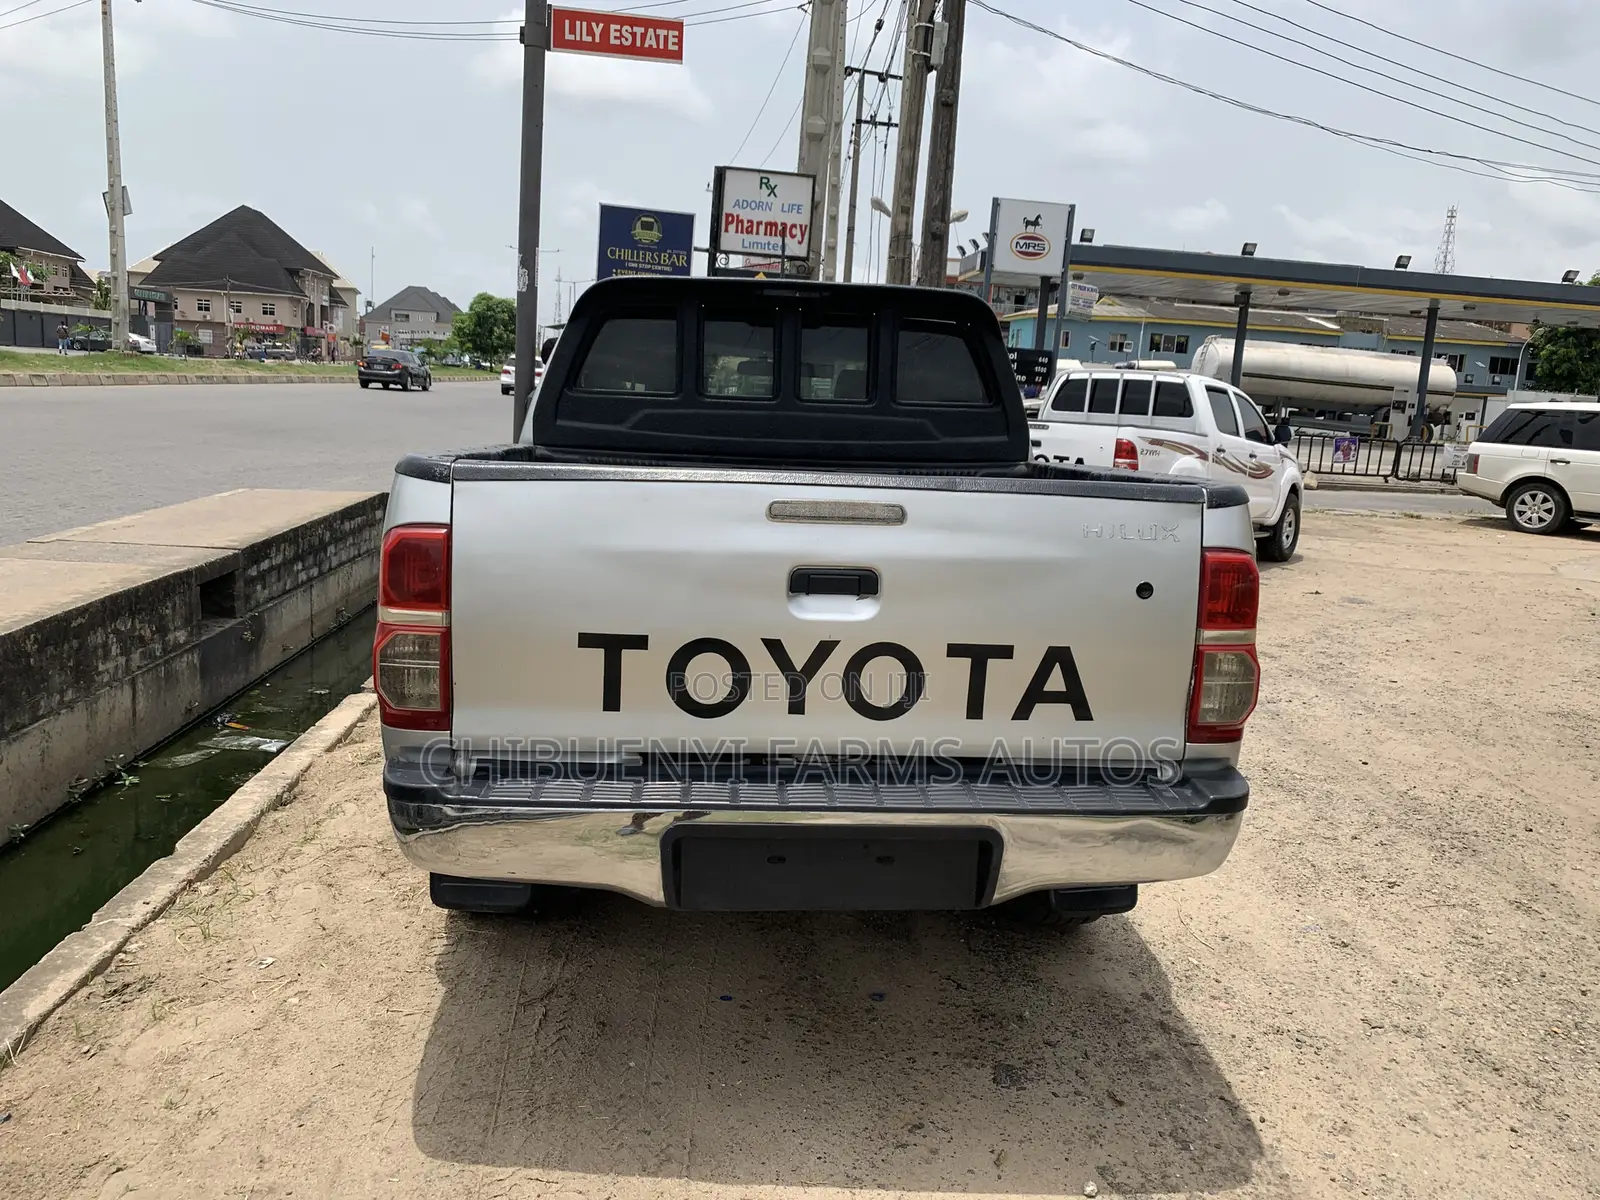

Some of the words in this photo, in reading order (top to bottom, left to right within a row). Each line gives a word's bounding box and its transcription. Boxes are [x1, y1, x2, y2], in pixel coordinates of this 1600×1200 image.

[564, 19, 604, 43] LILY
[609, 24, 679, 51] ESTATE
[732, 199, 773, 212] ADORN
[781, 203, 804, 214] LIFE
[724, 212, 808, 245] Pharmacy
[607, 246, 659, 264] CHILLERS
[661, 252, 688, 267] BAR
[1015, 241, 1046, 251] MRS
[1082, 523, 1180, 542] HILUX
[578, 632, 1094, 721] TOYOTA
